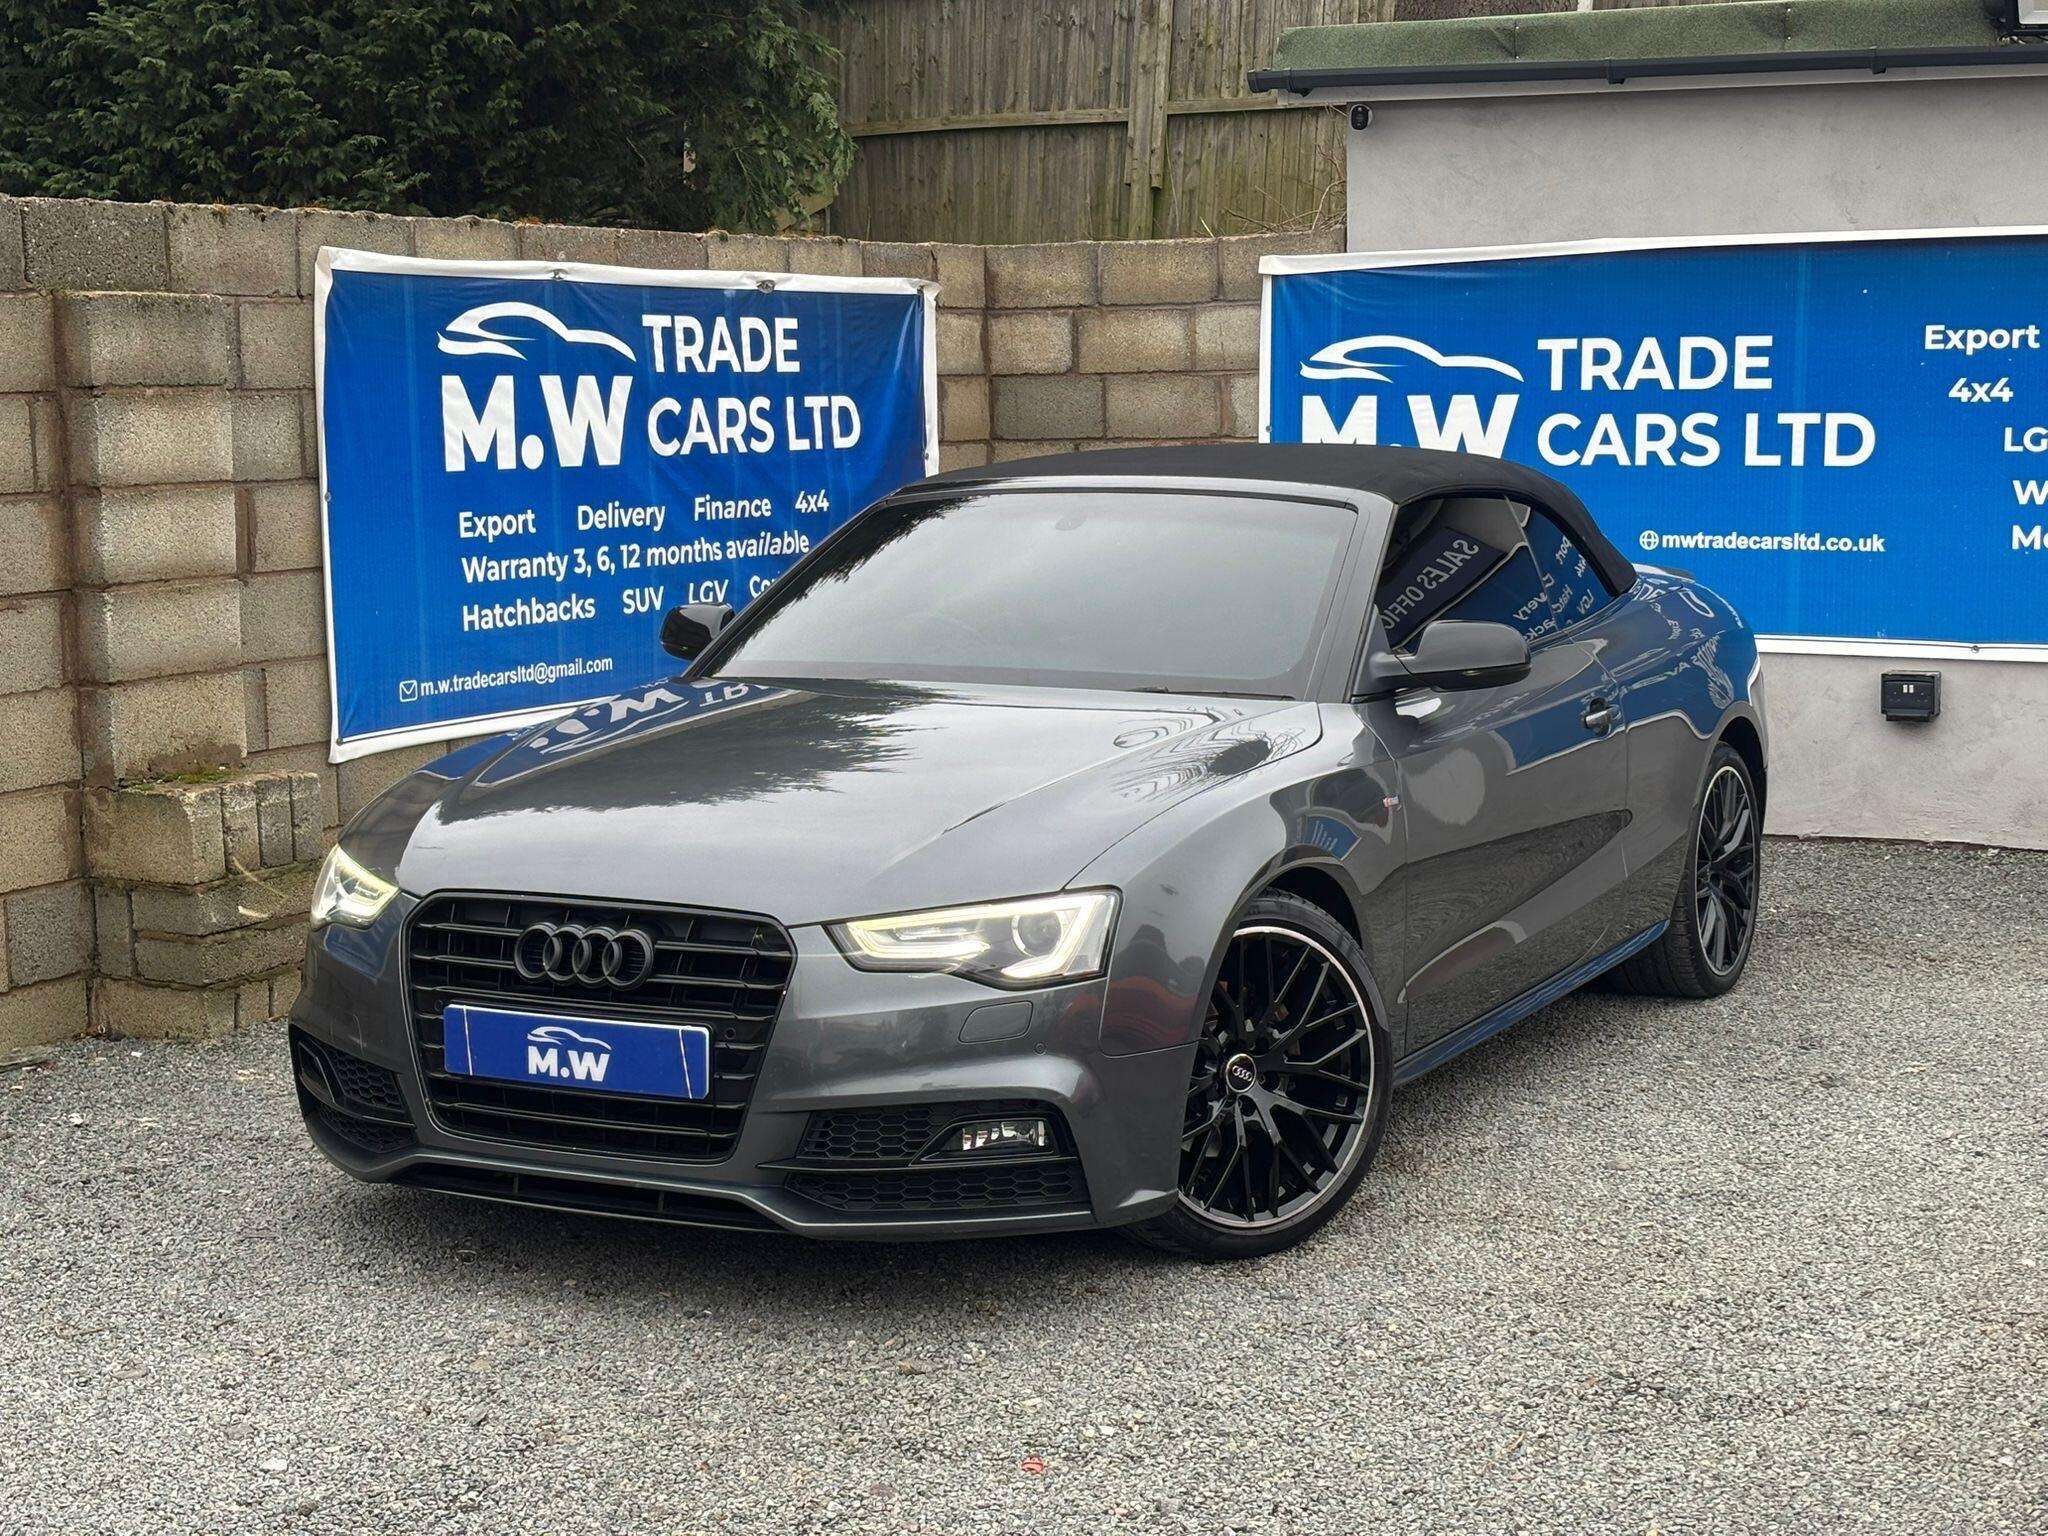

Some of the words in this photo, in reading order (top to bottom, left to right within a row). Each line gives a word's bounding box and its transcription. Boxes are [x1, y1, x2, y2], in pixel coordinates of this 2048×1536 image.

[642, 314, 801, 374] TRADE
[1537, 335, 1773, 391] TRADE
[1924, 324, 2041, 356] Export
[1948, 377, 2014, 403] 4x4
[441, 374, 634, 472] M.W
[647, 396, 775, 457] CARS
[785, 395, 861, 451] LTD
[1301, 393, 1520, 460] MW
[1537, 412, 1721, 467] CARS
[1744, 412, 1876, 467] LTD
[459, 509, 537, 542] Export
[577, 502, 666, 532] Delivery
[694, 494, 772, 522] Finance
[794, 489, 830, 513] 4x4
[1662, 530, 1885, 552] mwtradecarsltd.co.uk
[461, 552, 568, 584] Warranty
[573, 548, 592, 578] 3,
[596, 545, 616, 576] 6,
[619, 543, 641, 569] 12
[646, 539, 723, 567] months
[726, 530, 810, 560] available
[462, 593, 596, 632] Hatchbacks
[623, 586, 664, 614] SUV
[688, 579, 729, 604] LGV
[420, 657, 613, 698] m.w.tradecarsltd@gmail.com
[527, 1045, 610, 1082] M.W
